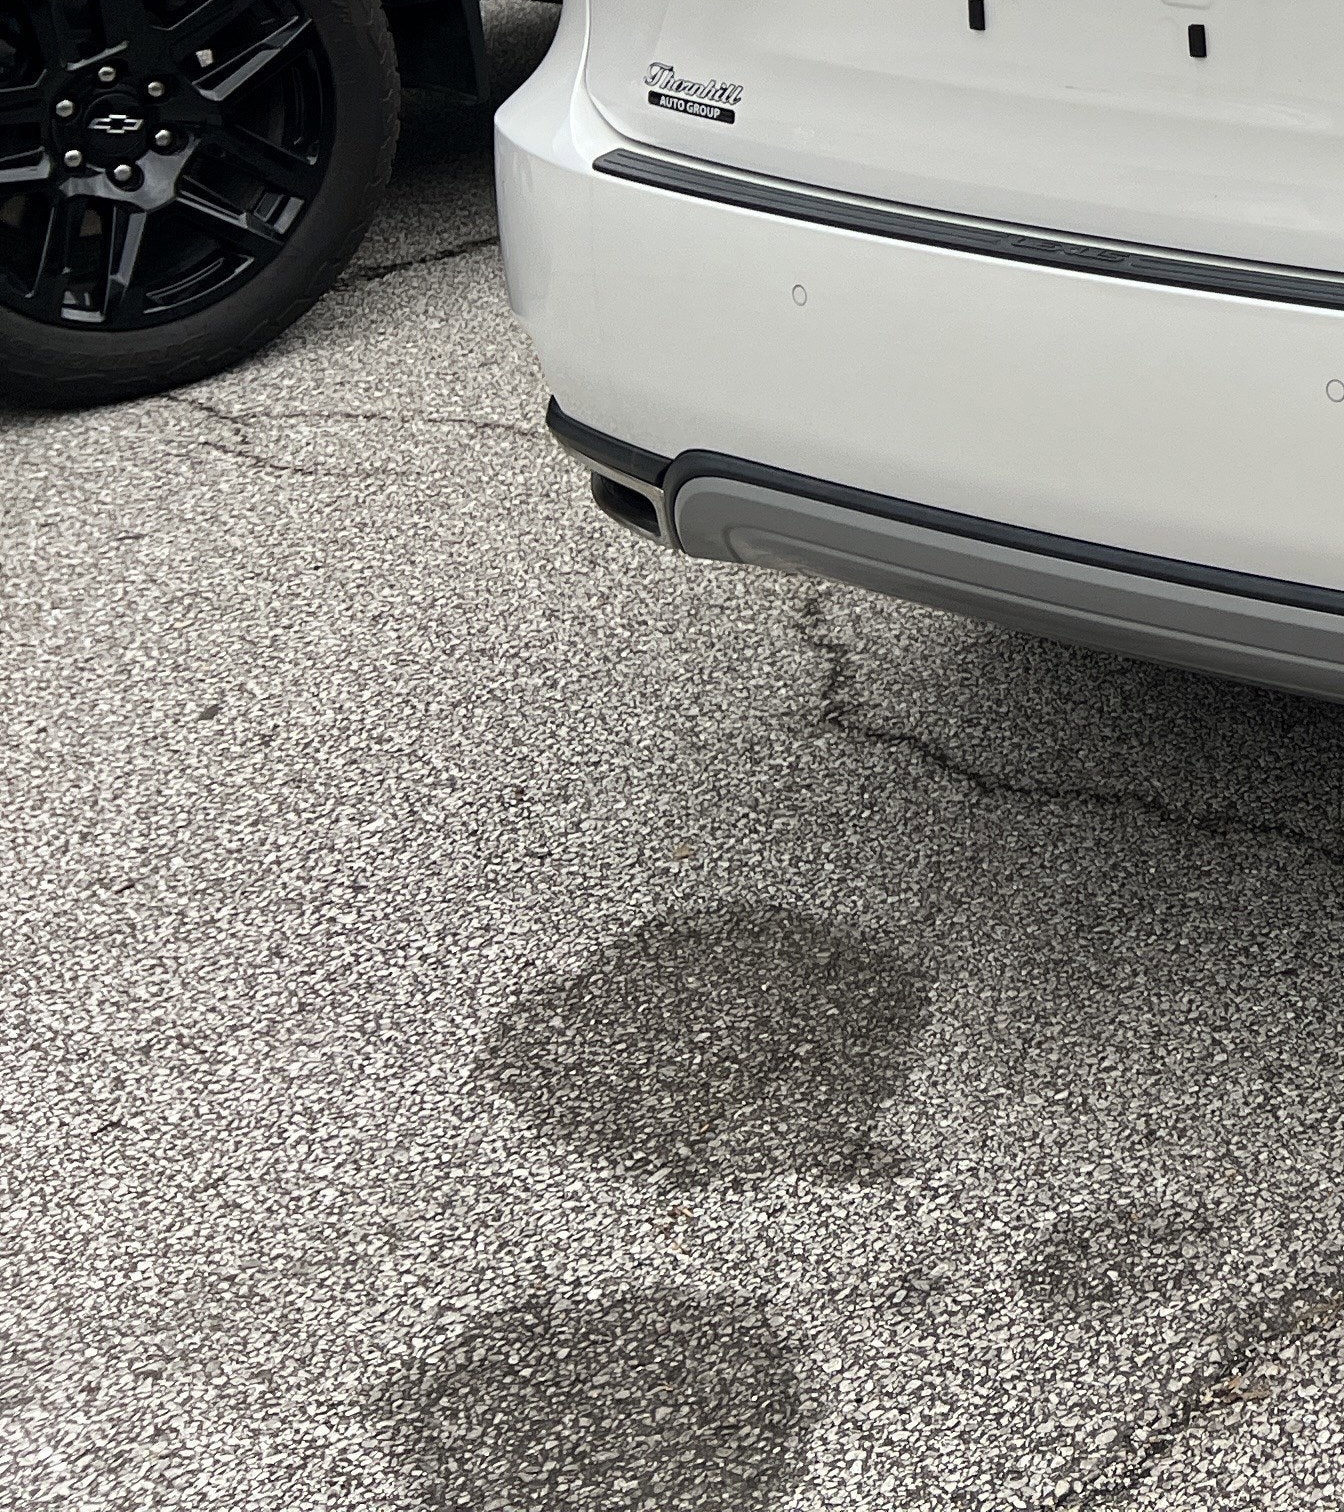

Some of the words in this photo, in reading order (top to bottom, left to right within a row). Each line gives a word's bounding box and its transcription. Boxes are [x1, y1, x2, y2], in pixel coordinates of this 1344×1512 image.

[643, 62, 744, 105] Thornhill
[660, 95, 685, 111] AUTO
[686, 102, 721, 119] GROUP
